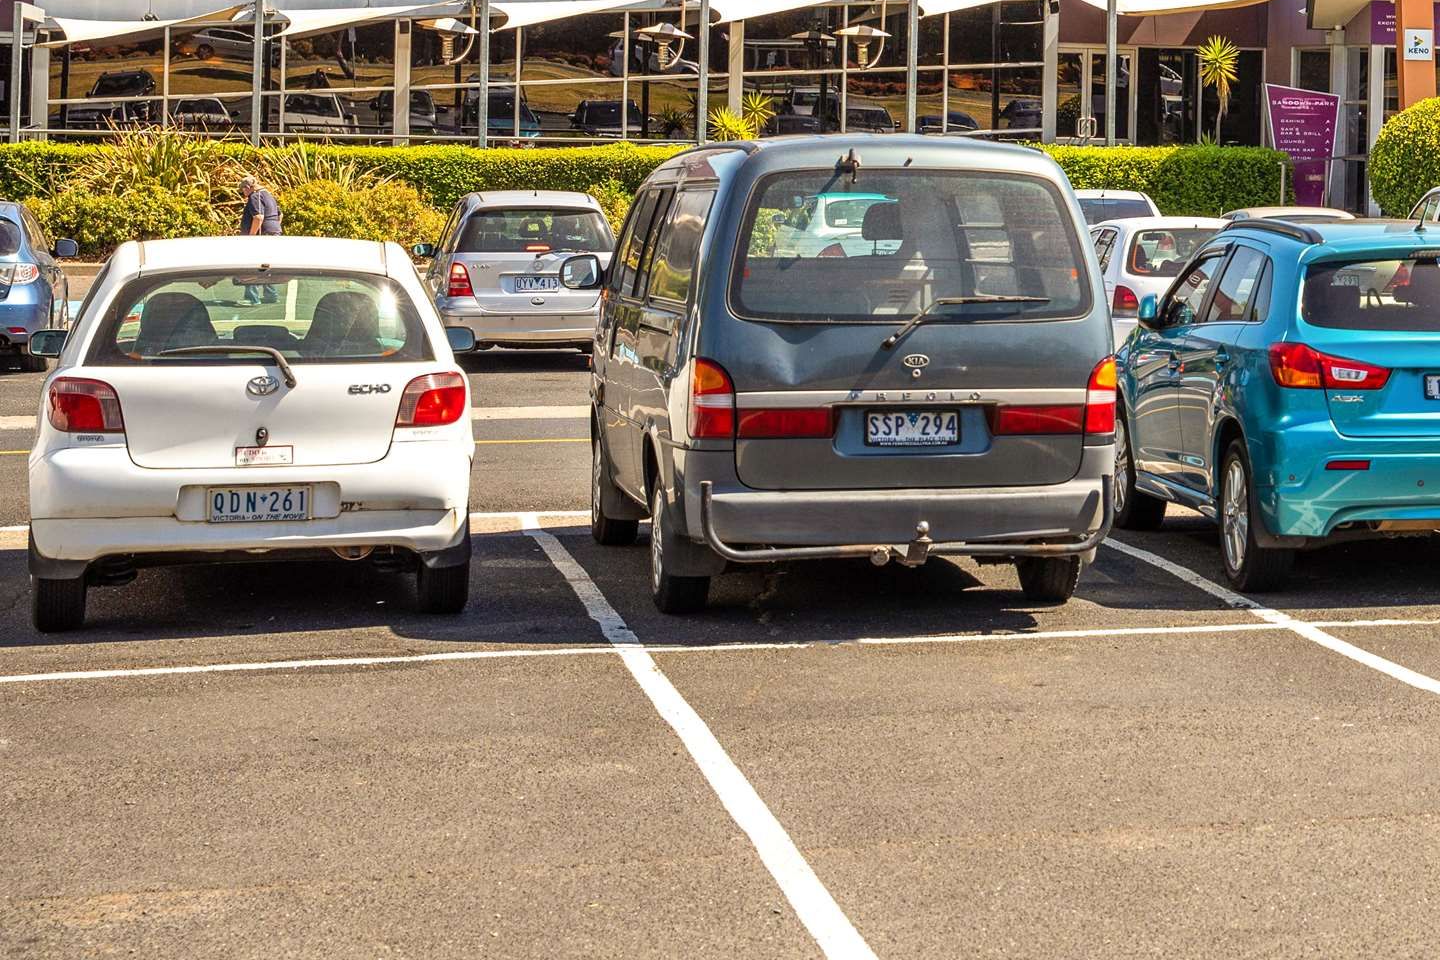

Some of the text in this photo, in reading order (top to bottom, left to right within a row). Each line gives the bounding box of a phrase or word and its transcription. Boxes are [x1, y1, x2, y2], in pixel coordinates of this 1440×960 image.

[907, 356, 926, 365] KIA
[347, 383, 392, 395] ECHO
[850, 392, 981, 401] PREGIO
[214, 491, 304, 514] QDN 261
[282, 512, 305, 520] MOVE
